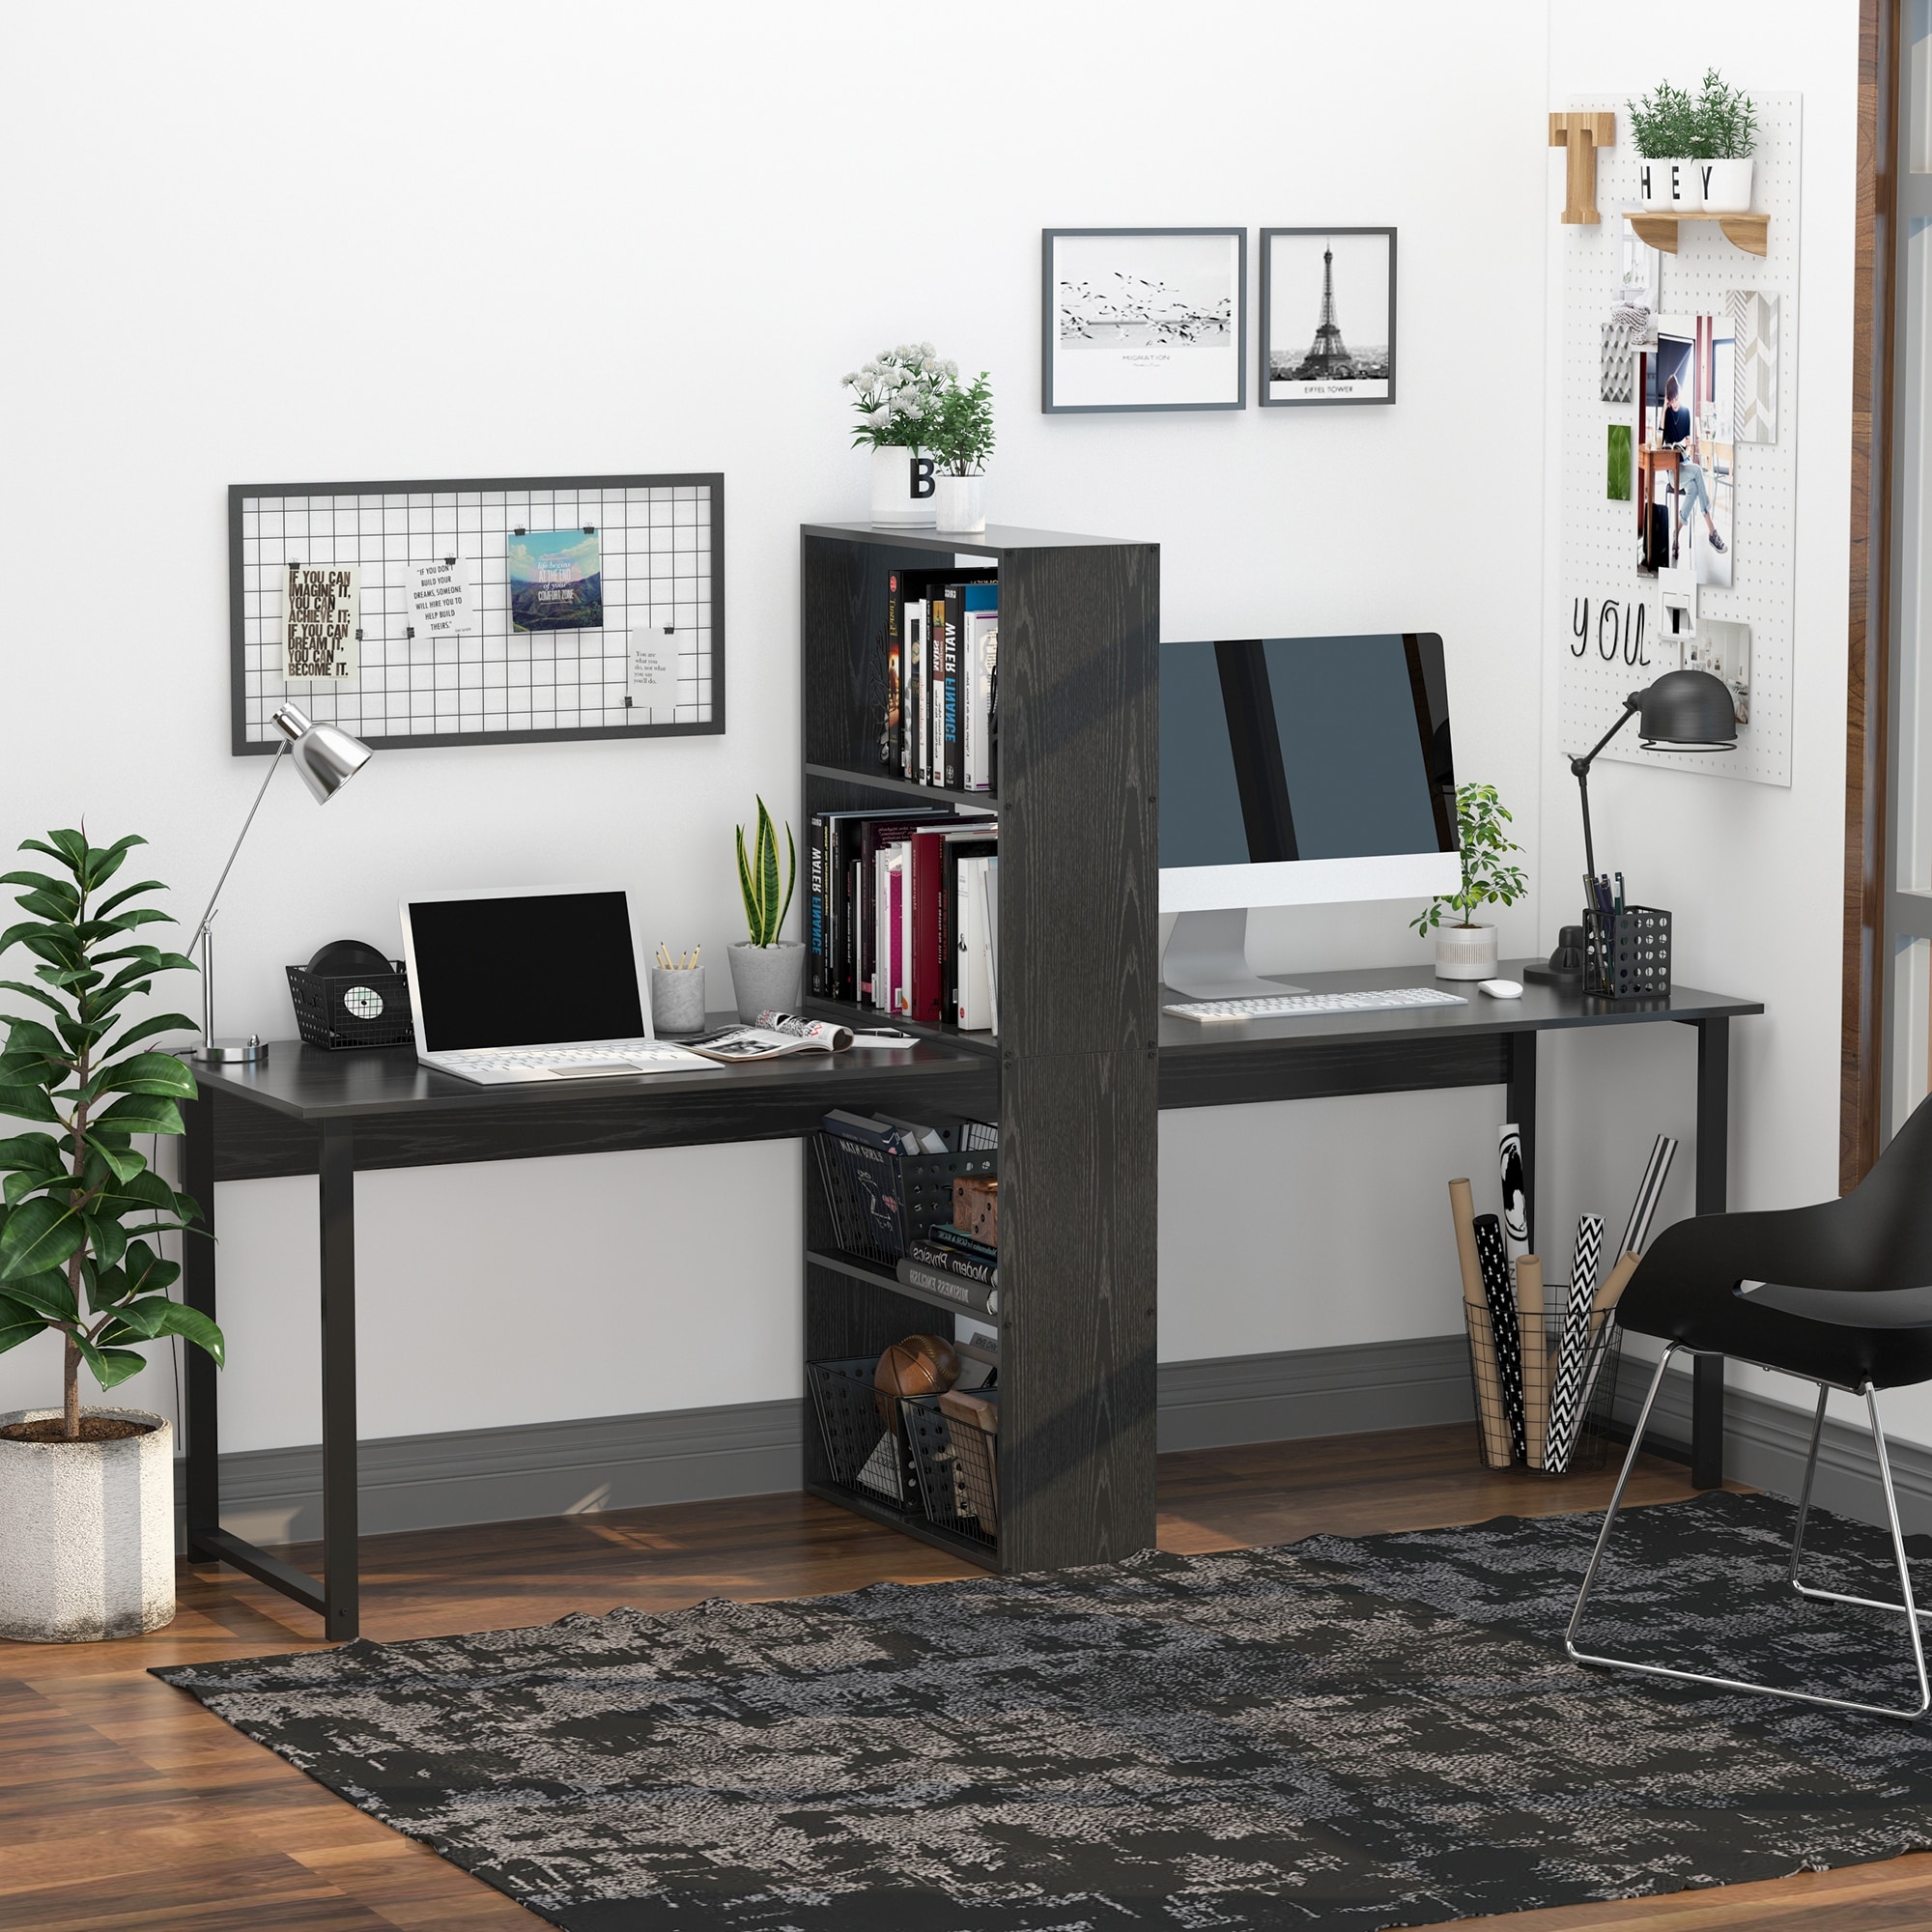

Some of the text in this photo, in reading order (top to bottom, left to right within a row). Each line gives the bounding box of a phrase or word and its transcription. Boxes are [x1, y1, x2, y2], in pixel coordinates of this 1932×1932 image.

[1548, 112, 1615, 224] T
[1304, 385, 1353, 394] EIFFEL TOWER
[910, 458, 936, 499] B
[426, 566, 437, 575] YOU
[438, 564, 454, 573] DONT
[289, 570, 351, 585] IF YOU CAN
[421, 576, 452, 587] BUILD YOUR
[288, 583, 352, 599] IMAGINE IT,
[436, 585, 462, 596] SOMEONE
[537, 589, 575, 601] COMFORT ZONE
[289, 596, 336, 611] YOU CAN
[429, 600, 441, 609] HIRE
[455, 596, 463, 605] TO
[288, 610, 333, 623] ACHIEVE
[425, 609, 456, 620] HELP BUILD
[288, 623, 349, 638] IF YOU CAN
[288, 637, 344, 652] DREAM IT,
[289, 650, 334, 664] YOU CAN
[288, 662, 349, 676] BECOME IT.
